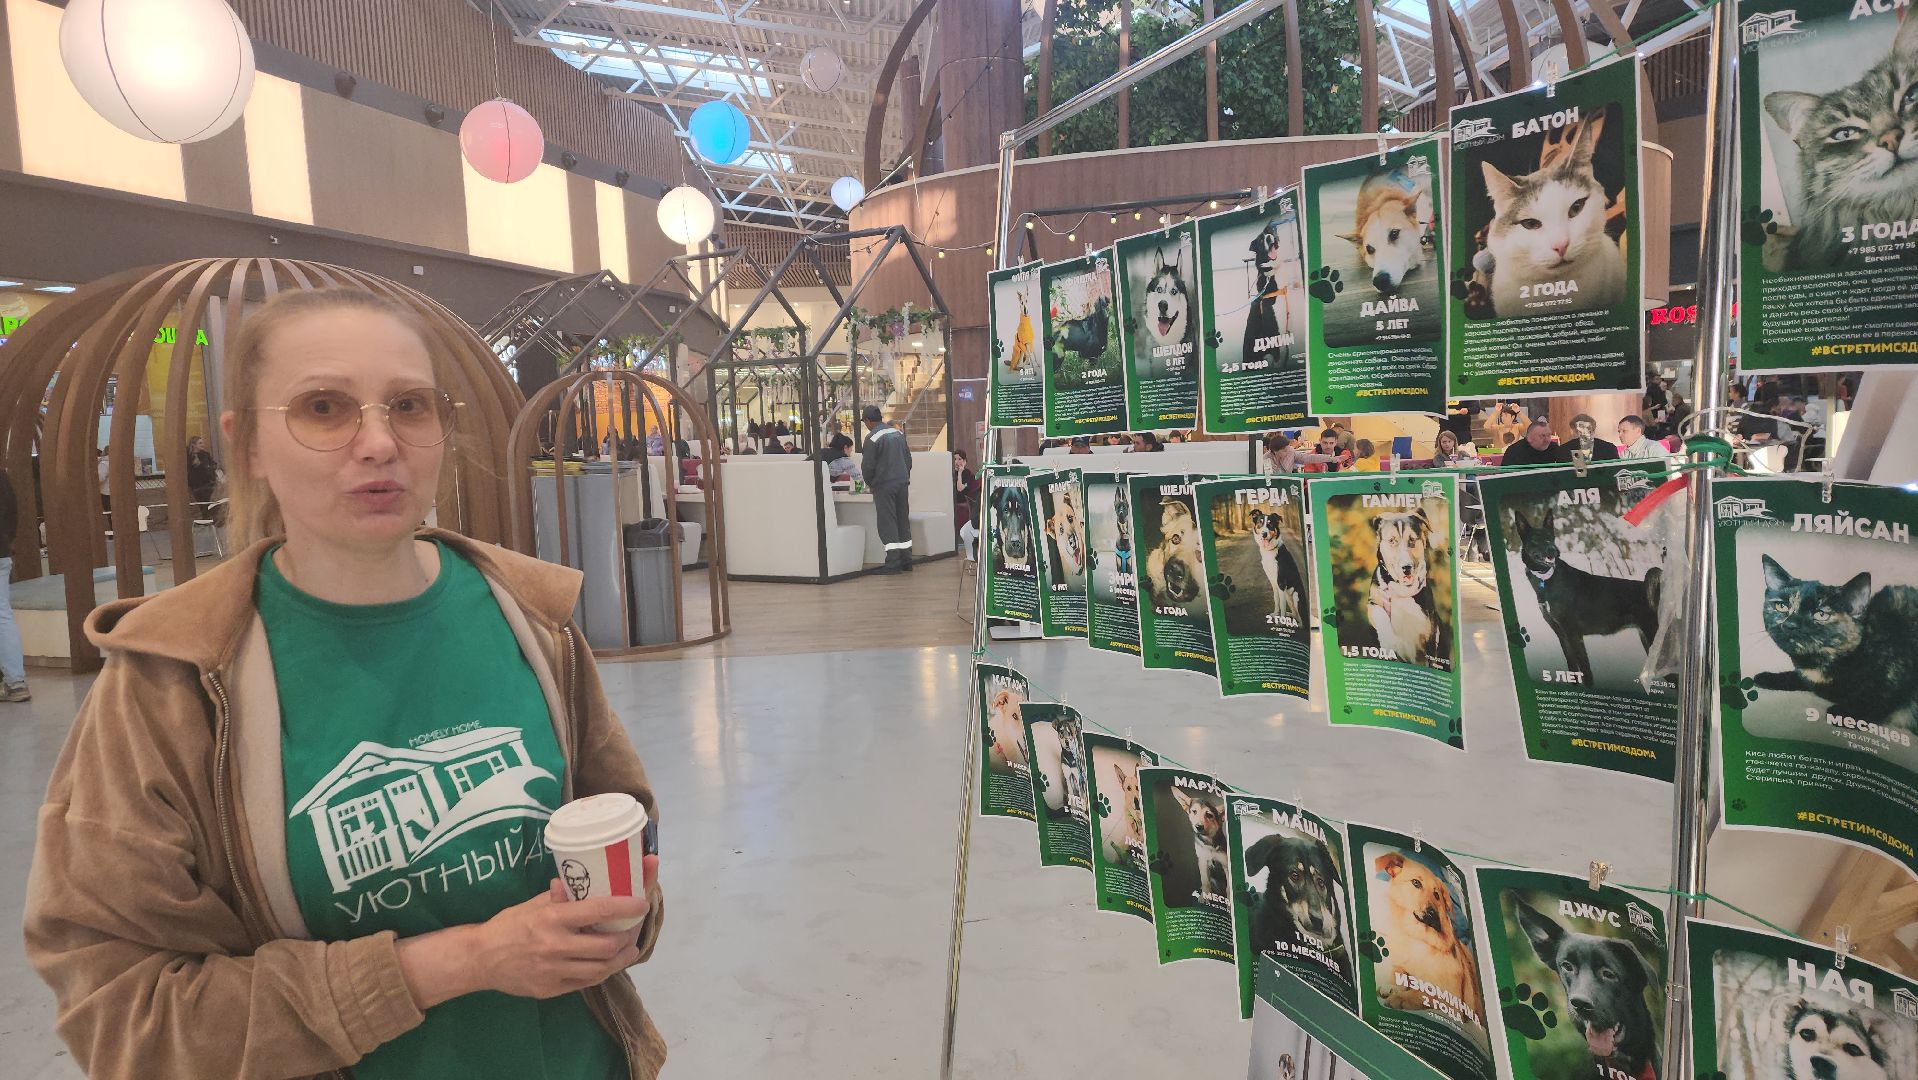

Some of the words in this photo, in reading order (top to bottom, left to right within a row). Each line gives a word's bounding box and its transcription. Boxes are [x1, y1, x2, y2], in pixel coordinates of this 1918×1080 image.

[1512, 106, 1580, 139] БАТОН
[1841, 227, 1855, 243] 3
[1862, 219, 1918, 241] ГОДА
[1865, 254, 1901, 263] Евгения
[1519, 285, 1530, 299] 2
[1533, 279, 1578, 298] ГОДА
[1360, 295, 1419, 318] ДАЙВА
[1375, 320, 1384, 331] 5
[1386, 318, 1410, 330] ЛЕТ
[1152, 342, 1193, 358] ШЕЛДОН
[1253, 333, 1295, 353] ДЖИМ
[1811, 341, 1918, 356] #ВСТРЕТИМСЯД
[1172, 356, 1186, 366] ЛЕТ
[1221, 362, 1240, 374] 2,5
[1241, 359, 1269, 371] года
[1087, 368, 1107, 378] ГОДА
[1497, 372, 1596, 386] #ВСТРЕТИМСЯДОМА
[1234, 487, 1290, 507] ГЕРДА
[1361, 493, 1423, 508] ГАМЛЕТ
[1557, 487, 1600, 506] АЛЯ
[1790, 509, 1909, 544] ЛЯЙСАН
[1155, 606, 1162, 615] 4
[1163, 606, 1189, 617] ГОДА
[1265, 614, 1273, 624] 2
[1274, 614, 1299, 628] ГОДА
[1341, 645, 1360, 658] 1,5
[1362, 646, 1398, 660] ГОДА
[1542, 669, 1552, 682] 5
[1555, 670, 1584, 684] ЛЕТ
[408, 728, 450, 748] HOMELY
[451, 720, 483, 736] HOME
[1805, 707, 1820, 722] 9
[1826, 713, 1910, 747] месяцев
[1571, 738, 1657, 759] #ВСТРЕТИМСЯДОМА
[1745, 750, 1766, 758] Киса
[1768, 752, 1796, 760] любит
[1847, 741, 1878, 755] Татьяна
[1745, 765, 1770, 774] будет
[1272, 808, 1329, 847] МАША
[1797, 810, 1915, 858] #ВСТРЕТИМСЯДОМА
[334, 824, 524, 923] УЮТНЫЙ
[1191, 889, 1200, 899] 4
[1559, 899, 1622, 928] ДЖУС
[1294, 931, 1301, 941] 1
[1302, 934, 1325, 951] ГОД
[1274, 940, 1289, 951] 10
[1291, 943, 1341, 972] МЕСЯЦЕВ
[1788, 957, 1875, 1010] НАЯ
[1394, 971, 1483, 1030] ИЗЮМИНКА
[1422, 995, 1431, 1007] 2
[1432, 999, 1464, 1025] ГОДА
[1596, 1063, 1605, 1077] 1
